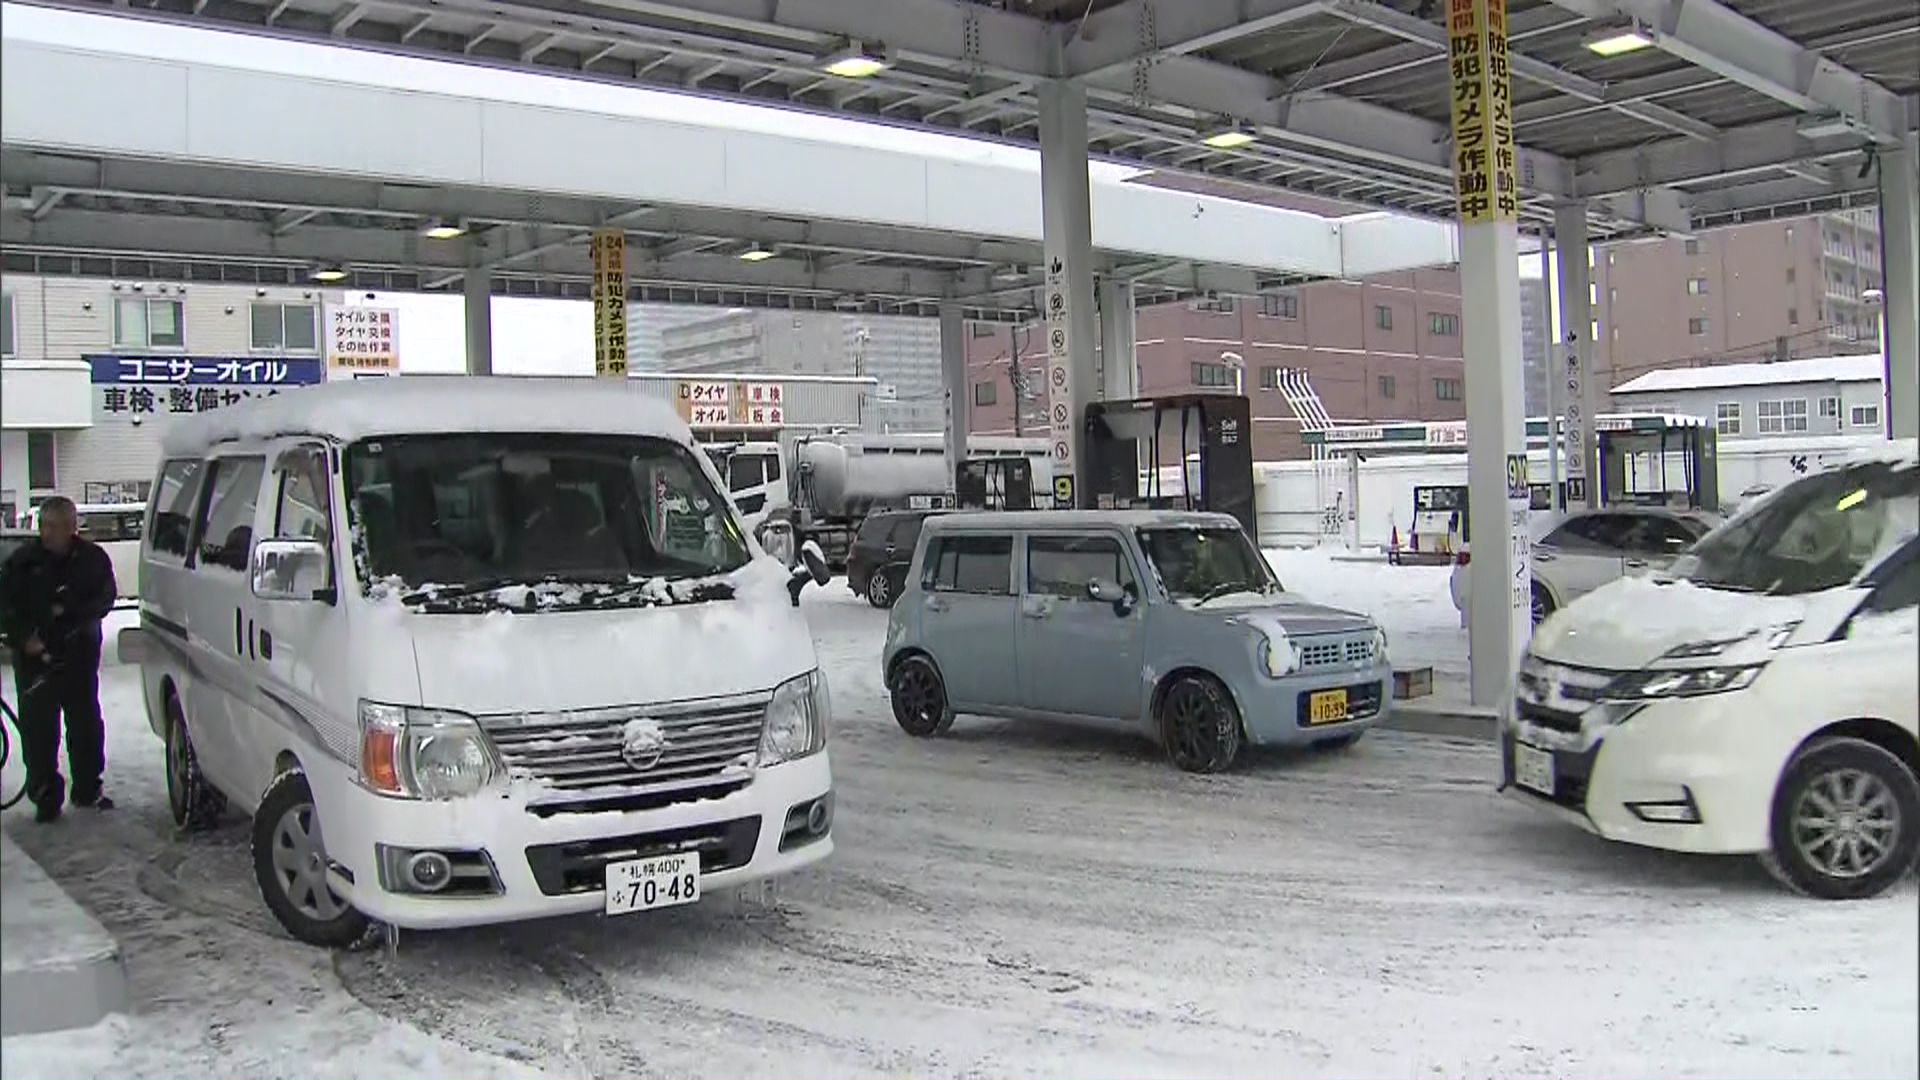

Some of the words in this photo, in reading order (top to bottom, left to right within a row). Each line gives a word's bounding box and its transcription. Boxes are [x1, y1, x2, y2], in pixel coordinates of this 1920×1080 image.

[119, 358, 288, 383] コニサーオイル
[103, 387, 281, 414] 車検・整備セ
[694, 385, 725, 400] タイヤ
[695, 408, 727, 423] オイル
[1055, 478, 1071, 500] 9
[1569, 480, 1583, 495] 11
[628, 874, 695, 907] 70-48
